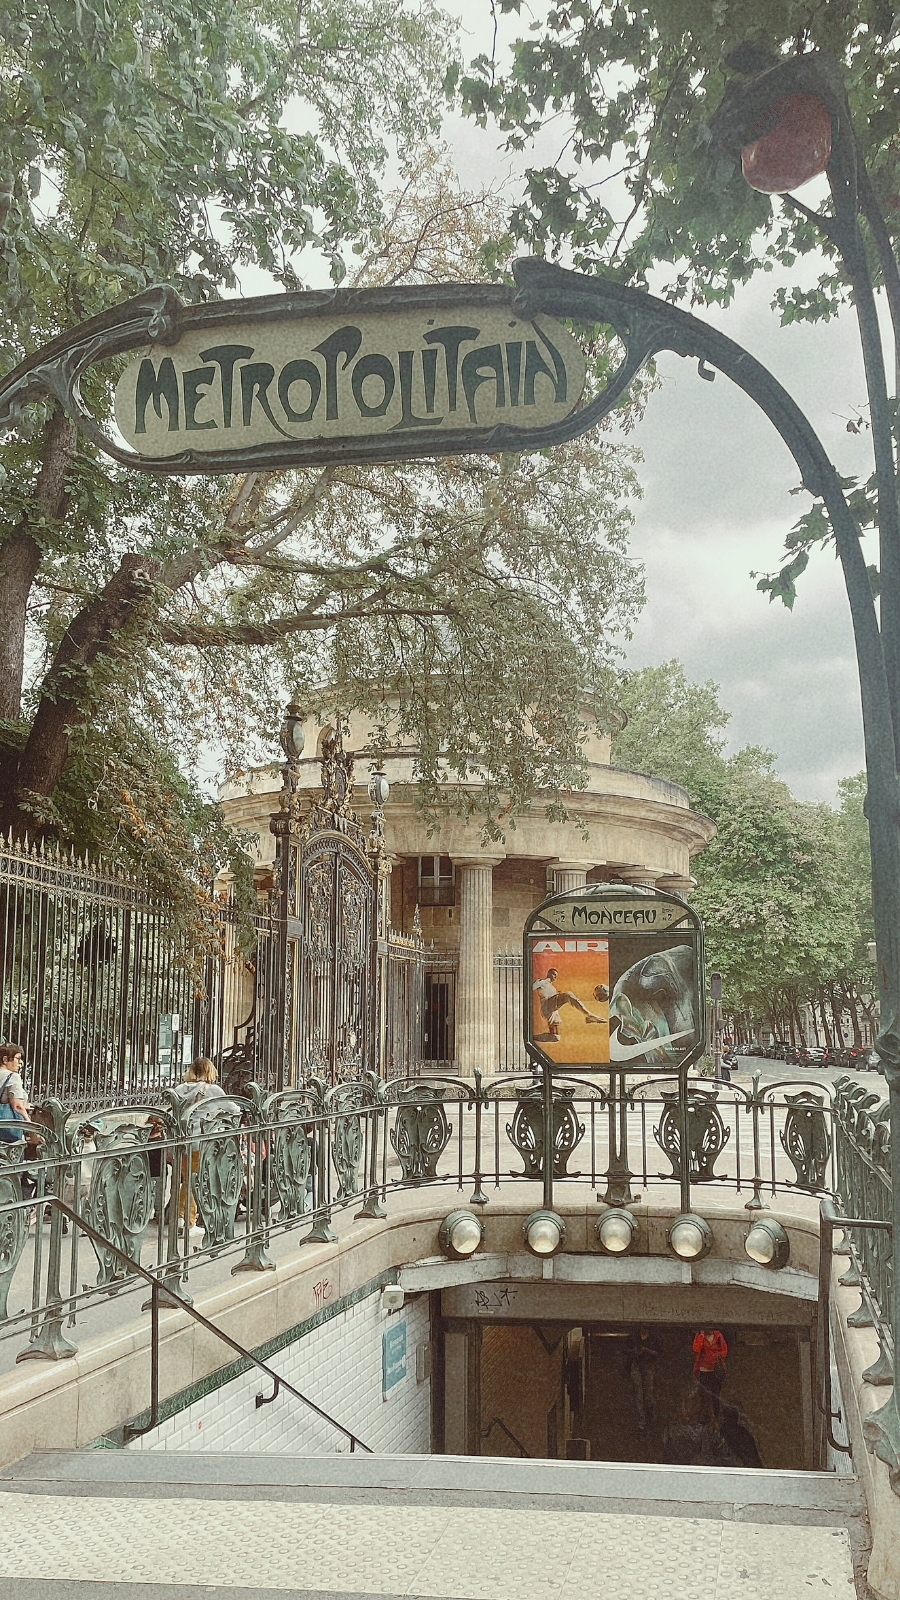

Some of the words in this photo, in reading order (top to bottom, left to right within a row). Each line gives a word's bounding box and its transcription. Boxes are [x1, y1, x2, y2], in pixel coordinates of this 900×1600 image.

[133, 318, 567, 439] METROPOLITAIN
[571, 905, 657, 927] MONCEAU
[532, 940, 609, 953] AIR
